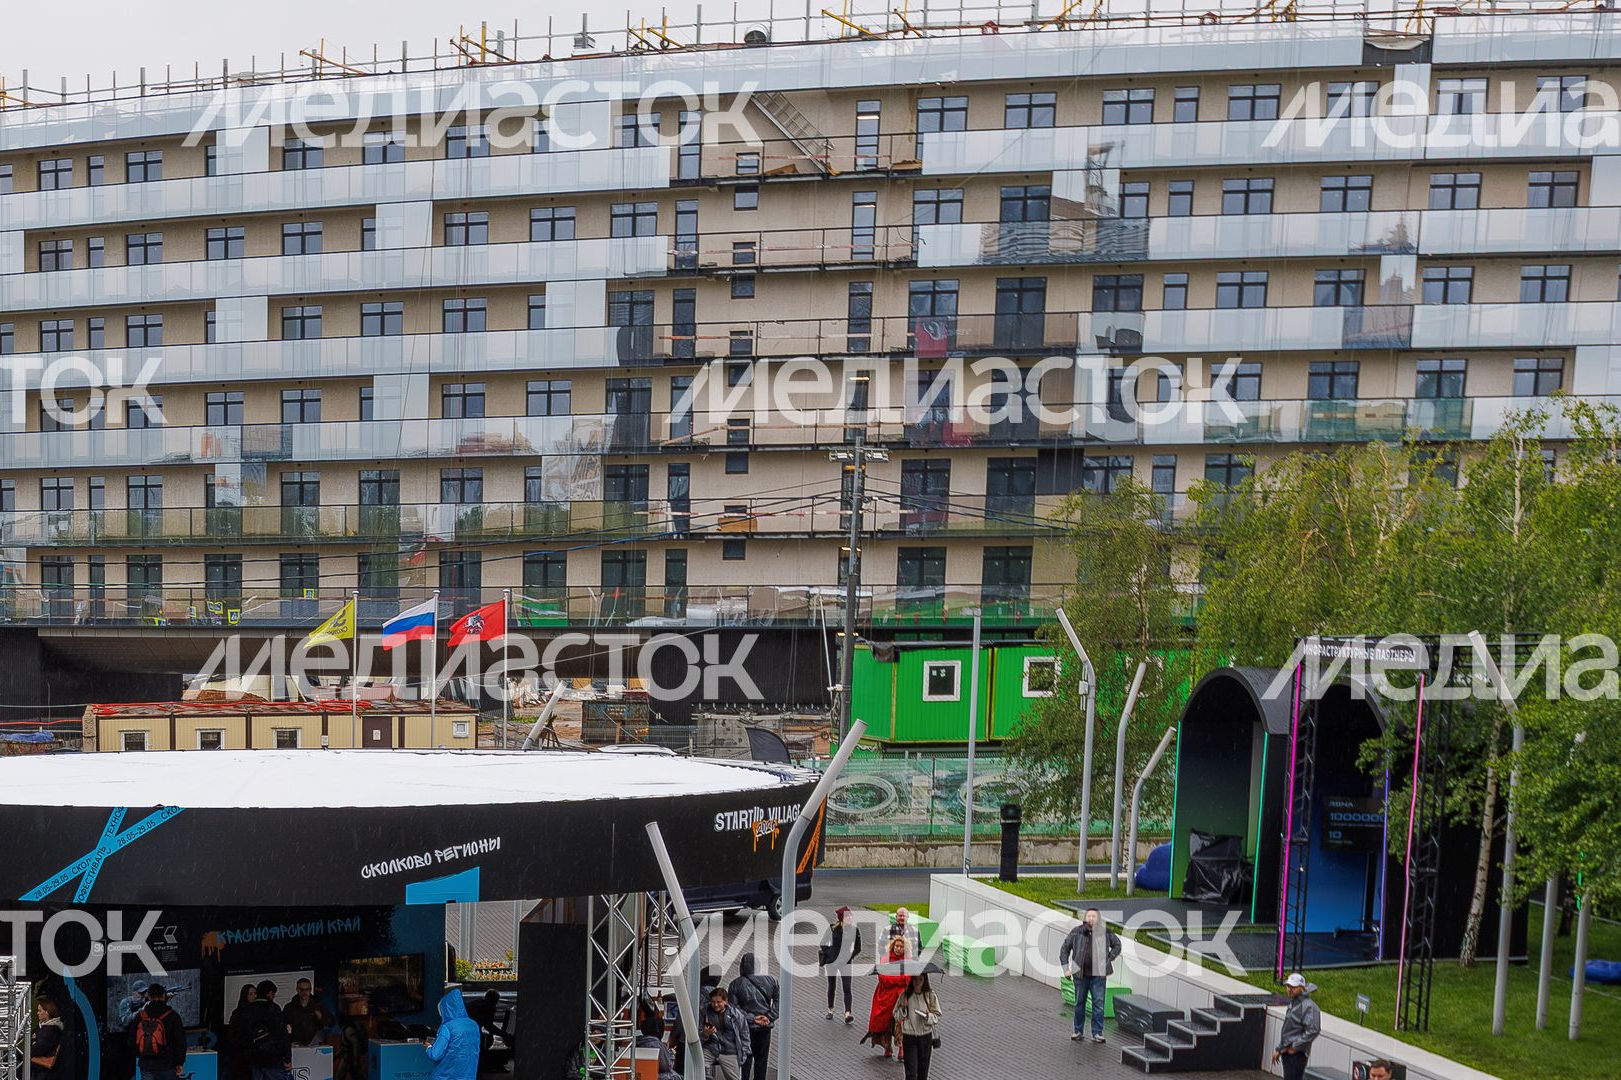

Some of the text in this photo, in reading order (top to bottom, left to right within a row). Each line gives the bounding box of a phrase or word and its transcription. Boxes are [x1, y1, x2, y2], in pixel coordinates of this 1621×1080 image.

[714, 806, 765, 832] STARTUP
[361, 836, 501, 879] СКОЛКОВО РЕГИОНЫ
